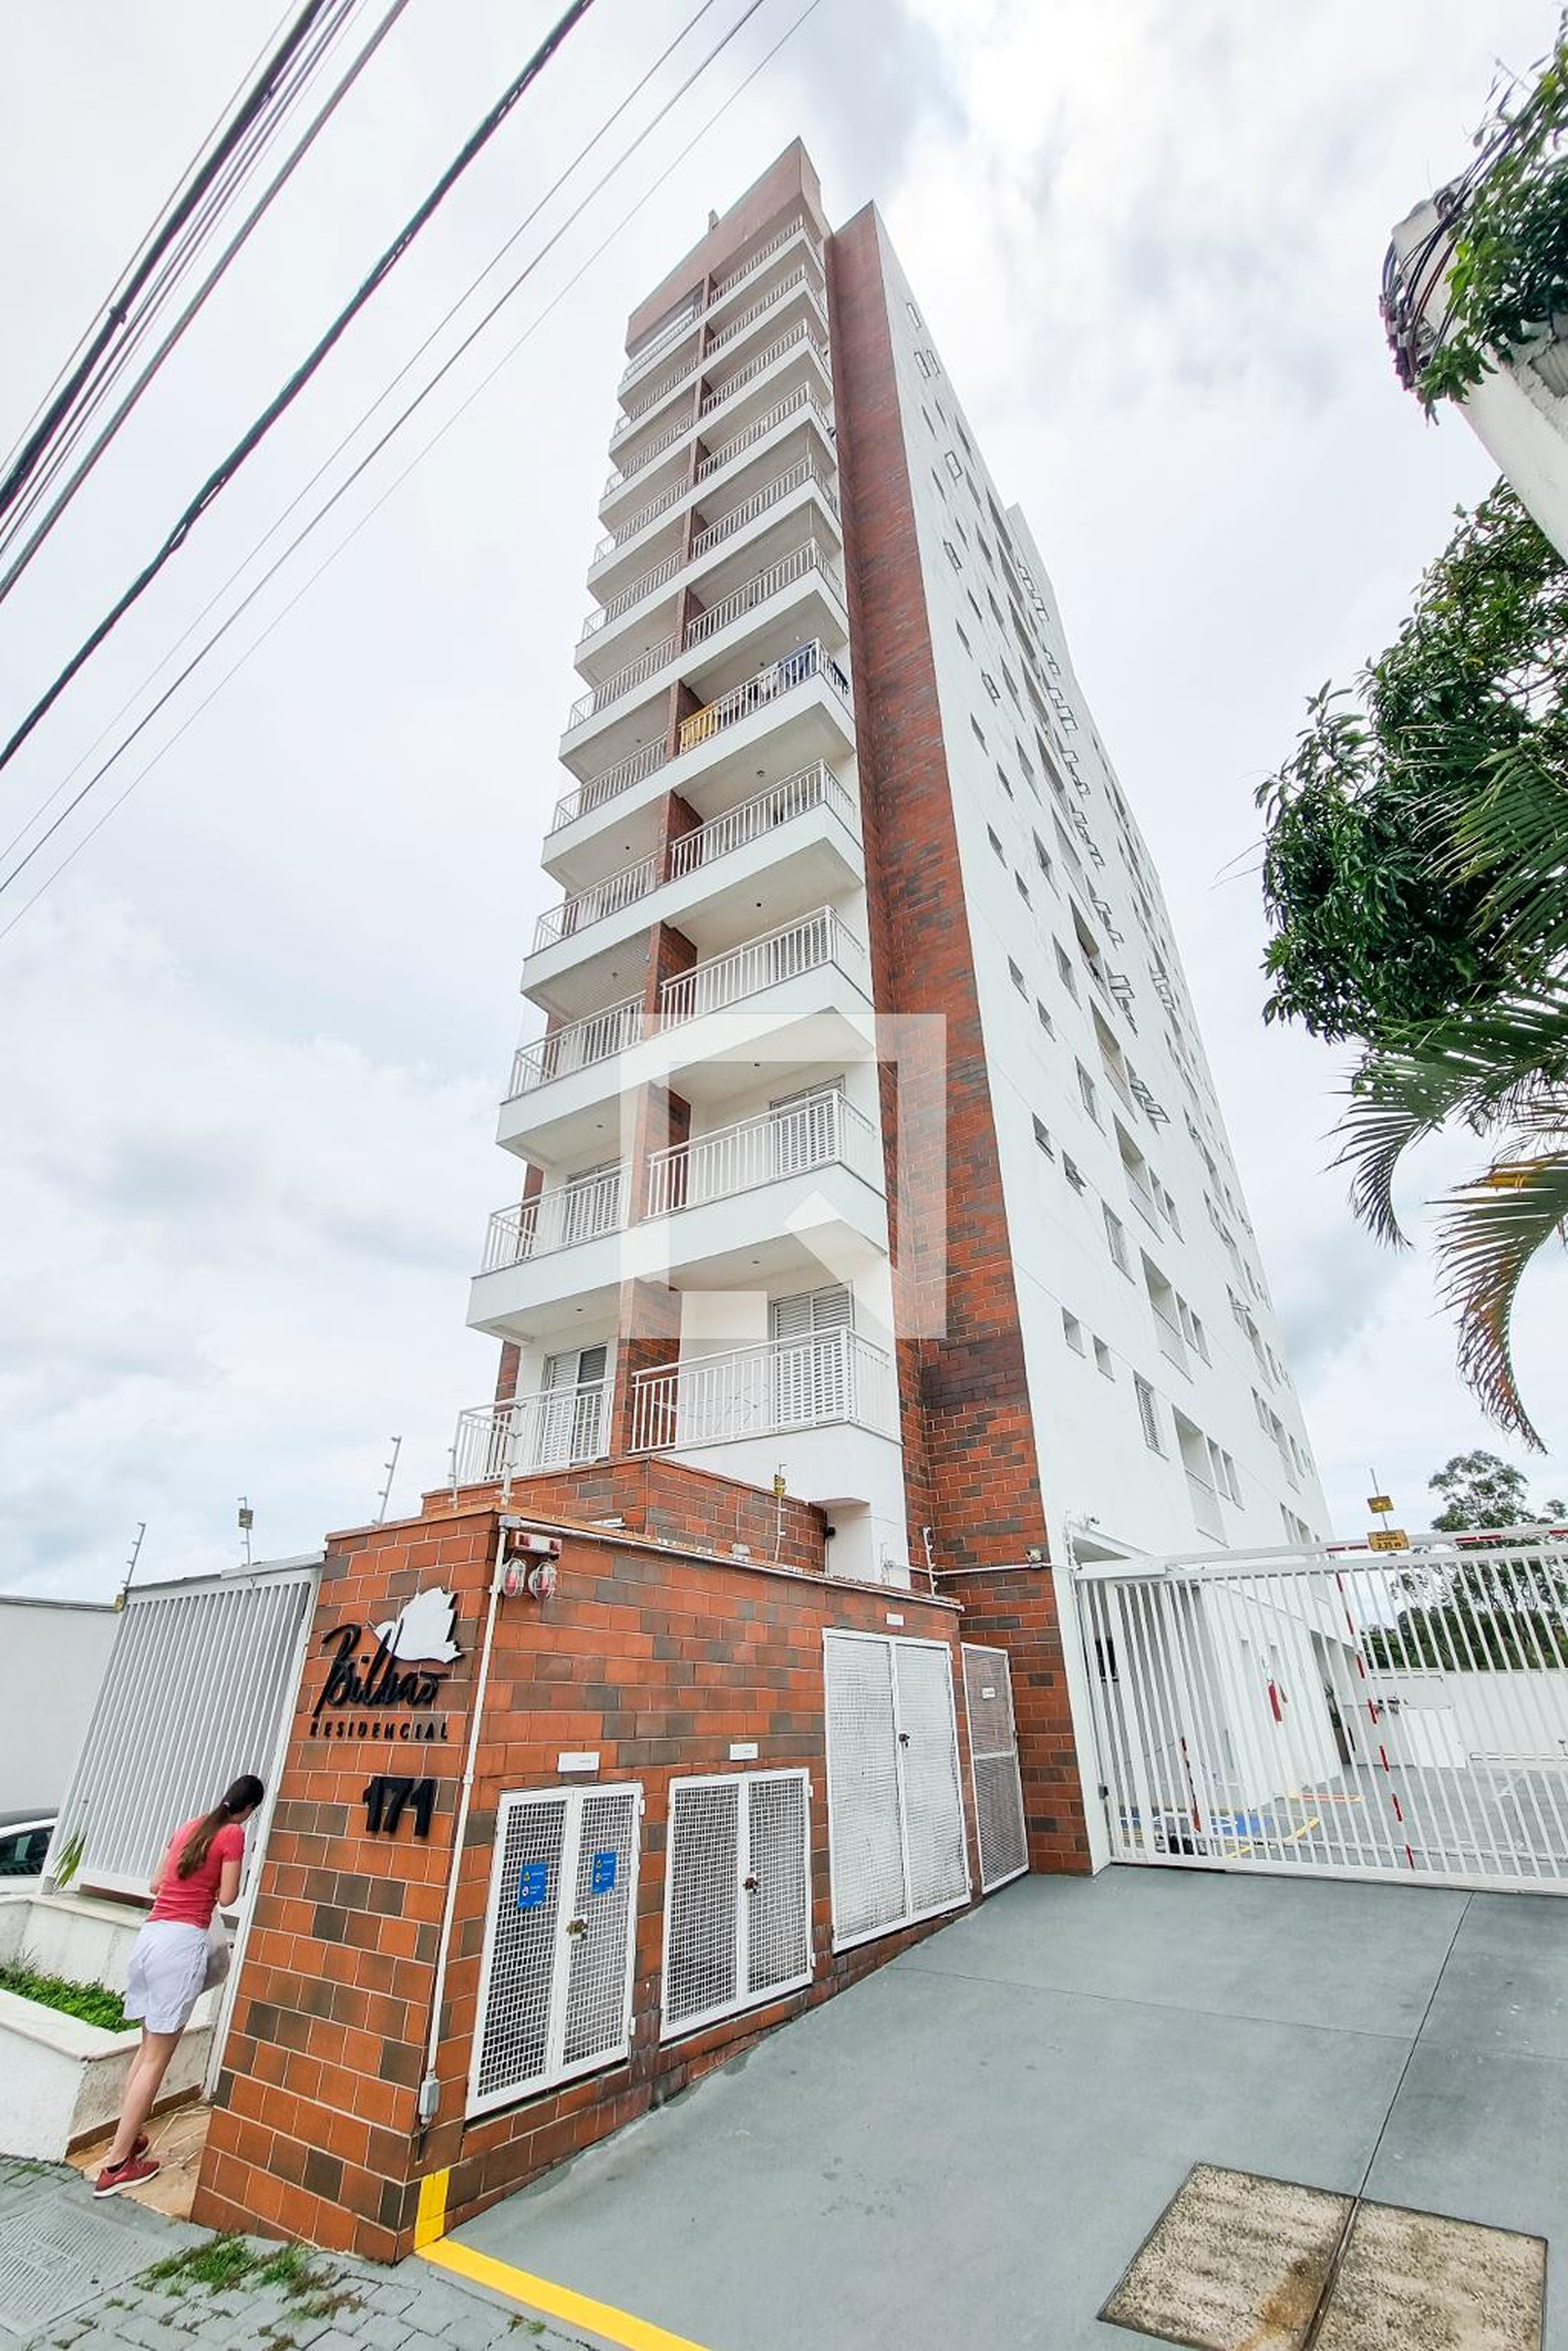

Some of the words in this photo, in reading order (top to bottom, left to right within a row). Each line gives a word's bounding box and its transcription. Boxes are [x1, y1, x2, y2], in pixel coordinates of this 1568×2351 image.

[312, 1617, 449, 1717] Bilbao
[309, 1721, 448, 1739] RESIDENCIAL
[363, 1776, 437, 1837] 171
